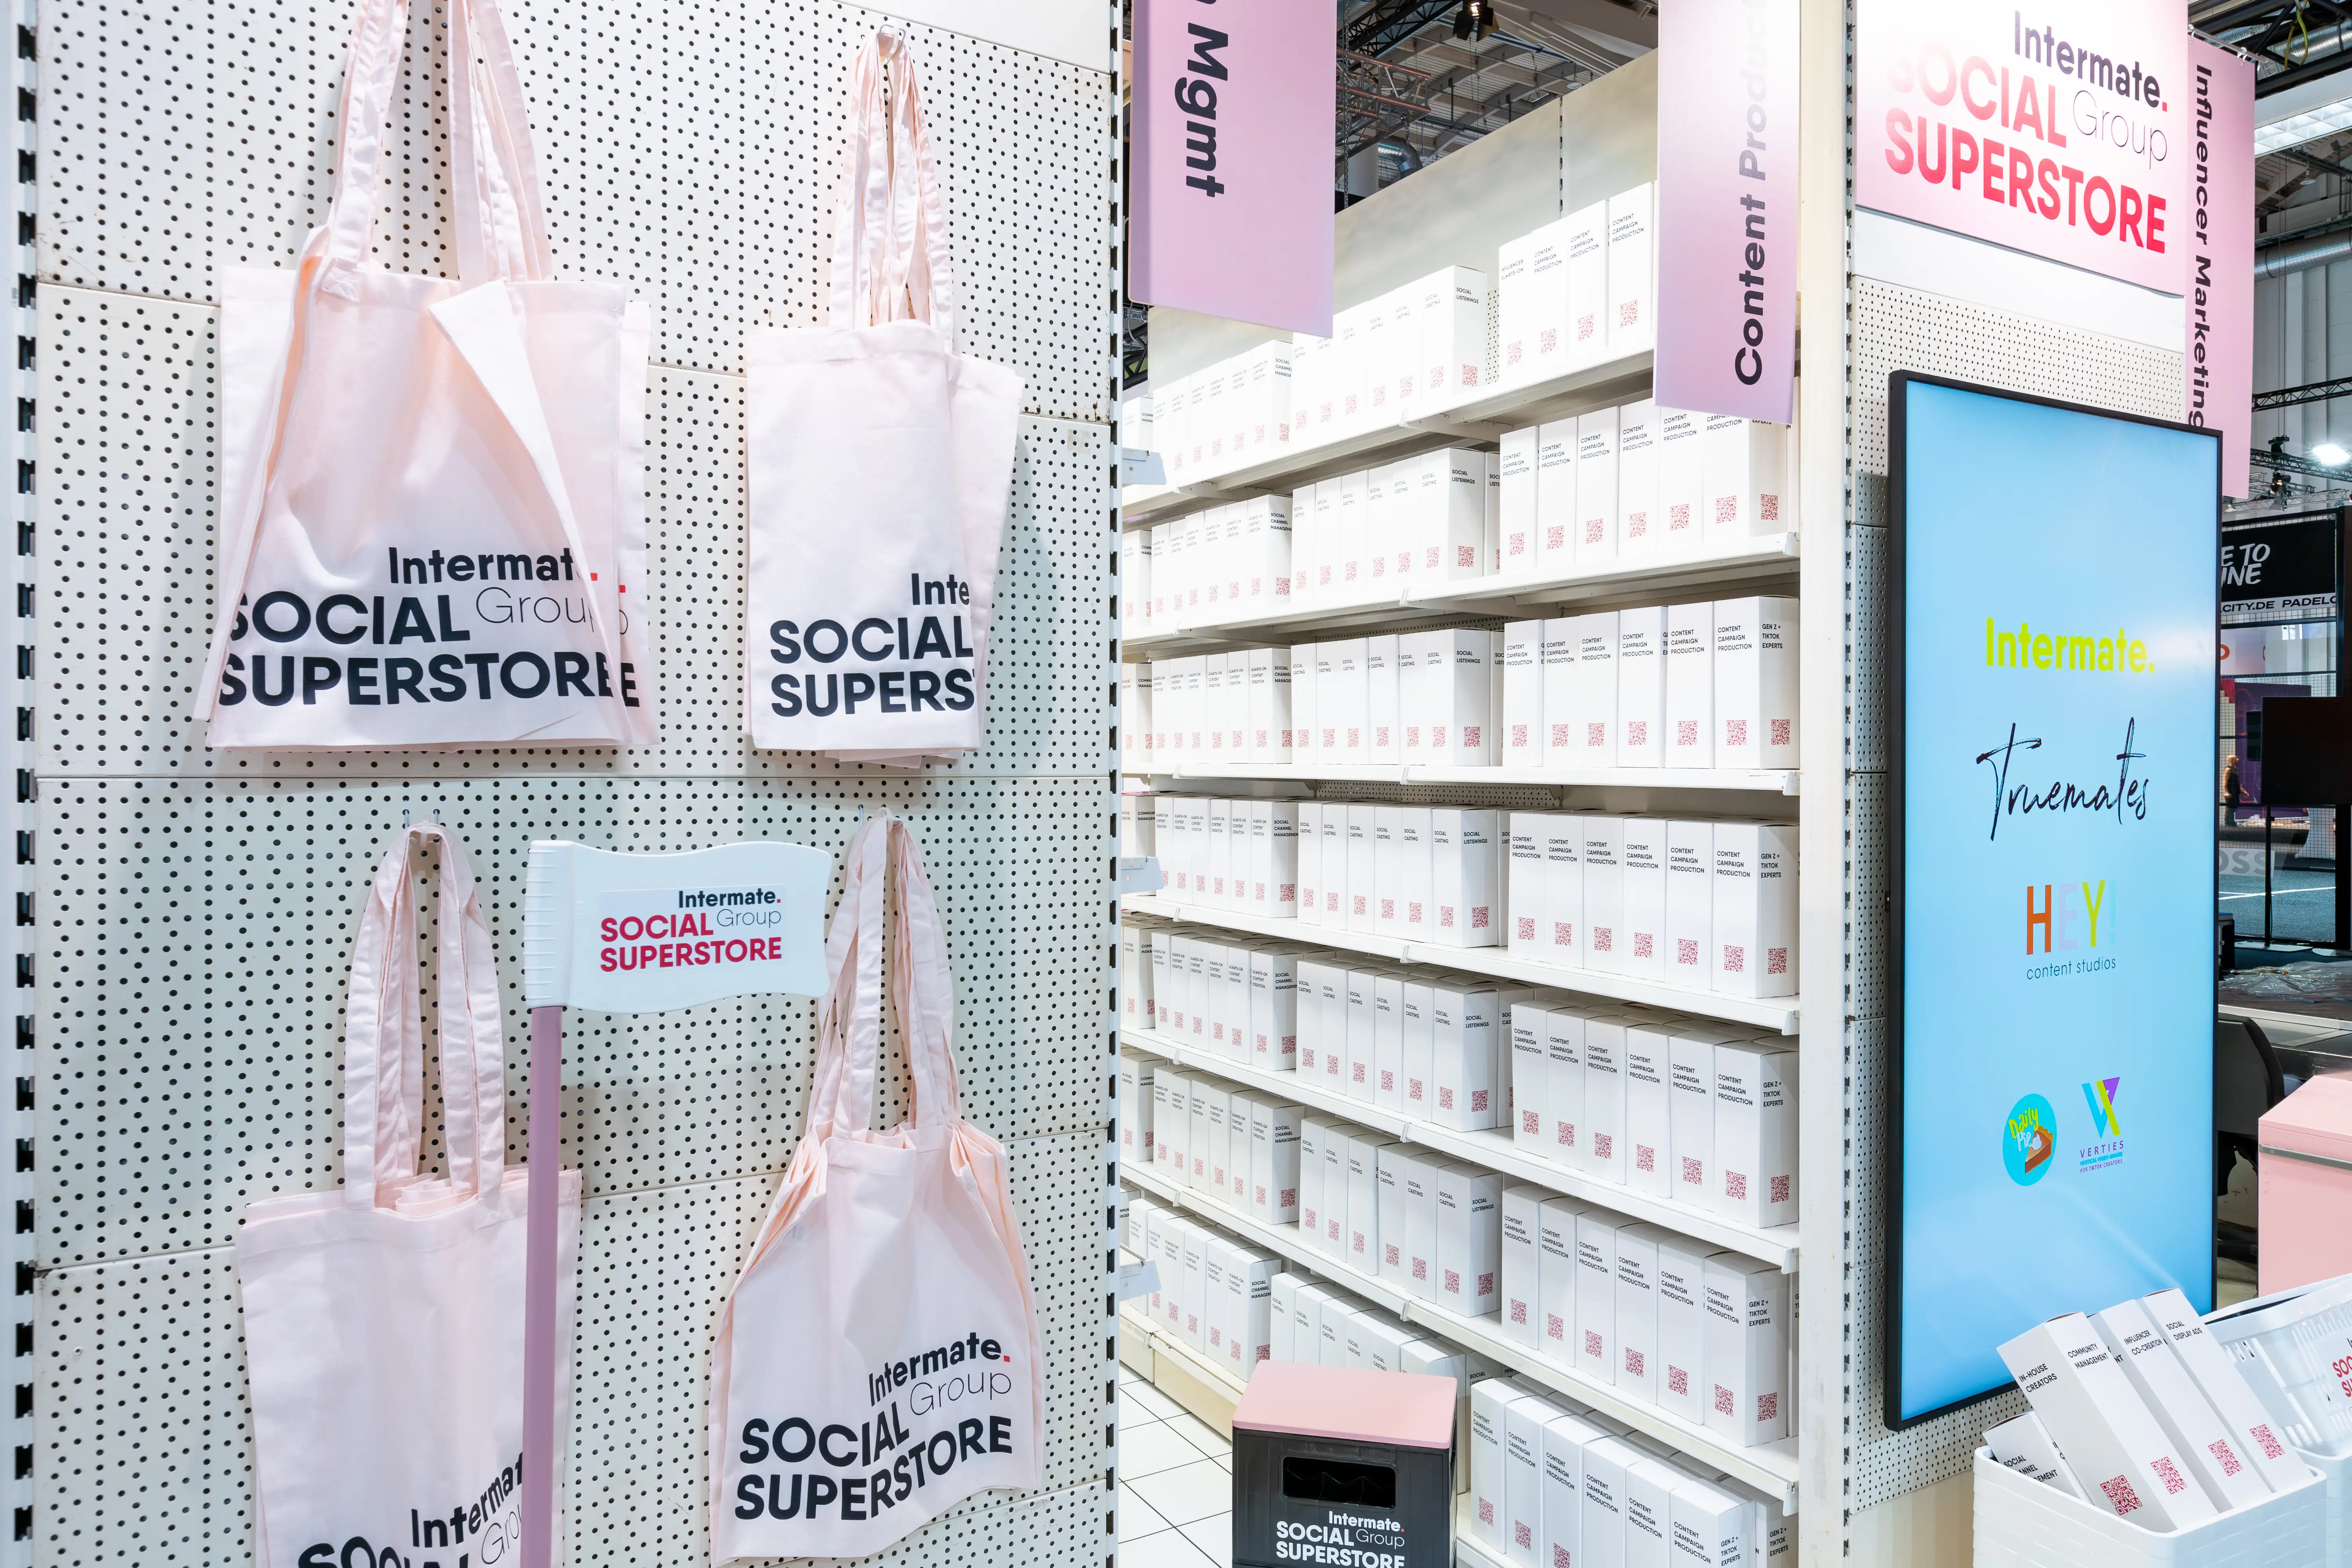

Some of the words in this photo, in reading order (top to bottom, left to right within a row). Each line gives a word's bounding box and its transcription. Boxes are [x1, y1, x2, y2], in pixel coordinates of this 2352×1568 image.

[2015, 10, 2167, 112] Intermate.
[1175, 22, 1228, 198] Mgmt
[1886, 41, 2067, 148] SOCIAL
[2073, 90, 2167, 169] Group
[2196, 65, 2212, 245] Influencer
[1885, 107, 2166, 253] SUPERSTORE
[1613, 213, 1634, 226] CONTENT
[1613, 221, 1637, 234] CAMPAIGN
[1613, 227, 1644, 242] PRODUCTION
[1571, 230, 1590, 242] CONTENT
[1571, 238, 1593, 250] CAMPAIGN
[1571, 244, 1599, 258] PRODUCTION
[1501, 260, 1523, 271] INFLUENCER
[1501, 267, 1523, 279] ALWAYS-ON
[1734, 194, 1766, 385] Content
[1457, 295, 1479, 303] LISTENINGS
[1664, 414, 1686, 424] CONTENT
[1664, 422, 1690, 433] CAMPAIGN
[1664, 430, 1697, 441] PRODUCTION
[2239, 543, 2270, 566] TO
[911, 573, 969, 605] Inte
[2221, 601, 2275, 613] CITY.DE
[770, 616, 974, 664] SOCIAL
[1987, 618, 2155, 673] Intermate.
[771, 668, 975, 717] SUPERS
[1976, 717, 2149, 840] Truemates
[679, 888, 781, 908] Intermate.
[601, 913, 713, 942] SOCIAL
[717, 908, 781, 928] Group
[601, 936, 782, 972] SUPERSTORE
[2027, 961, 2072, 980] content
[2077, 956, 2116, 973] studios
[1719, 1074, 1742, 1084] CONTENT
[1718, 1083, 1746, 1094] CAMPAIGN
[1718, 1093, 1753, 1105] PRODUCTION
[1253, 1120, 1267, 1129] ALWAYS-ON
[2009, 1107, 2039, 1139] Daily
[2017, 1131, 2031, 1152] Pie
[2080, 1140, 2123, 1158] VERTIES
[2103, 1159, 2123, 1167] CREATORS
[1439, 1191, 1453, 1200] SOCIAL
[1439, 1199, 1455, 1208] CASTING
[1472, 1204, 1494, 1212] LISTENINGS
[1707, 1287, 1729, 1301] CONTENT
[1707, 1297, 1733, 1312] CAMPAIGN
[1297, 1310, 1307, 1319] SOCIAL
[1708, 1305, 1739, 1324] PRODUCTION
[1297, 1319, 1308, 1327] CASTING
[1749, 1318, 1770, 1327] EXPERTS
[2166, 1321, 2185, 1330] SOCIAL
[2124, 1330, 2151, 1345] INFLUENCER
[2173, 1330, 2192, 1340] DISPLAY
[2068, 1343, 2098, 1358] COMMUNITY
[2132, 1339, 2163, 1355] CO-CREATION
[2074, 1353, 2108, 1369] MANAGEMENT
[869, 1332, 1010, 1407] Intermate.
[2019, 1363, 2048, 1382] IN-HOUSE
[2026, 1373, 2057, 1392] CREATORS
[739, 1401, 909, 1467] SOCIAL
[910, 1372, 1011, 1416] Group
[735, 1416, 1012, 1520] SUPERSTORE
[2004, 1455, 2026, 1467] SOCIAL
[411, 1452, 522, 1548] Intermat
[1329, 1511, 1405, 1532] Intermate.
[1276, 1521, 1354, 1546] SOCIAL
[1356, 1529, 1405, 1549] Group
[1674, 1522, 1699, 1538] CONTENT
[1674, 1531, 1704, 1550] CAMPAIGN
[1721, 1539, 1730, 1547] GEN
[1276, 1541, 1405, 1568] SUPERSTORE
[1674, 1540, 1711, 1564] PRODUCTION
[1721, 1545, 1737, 1557] TIKTOK
[1721, 1554, 1740, 1566] EXPERTS
